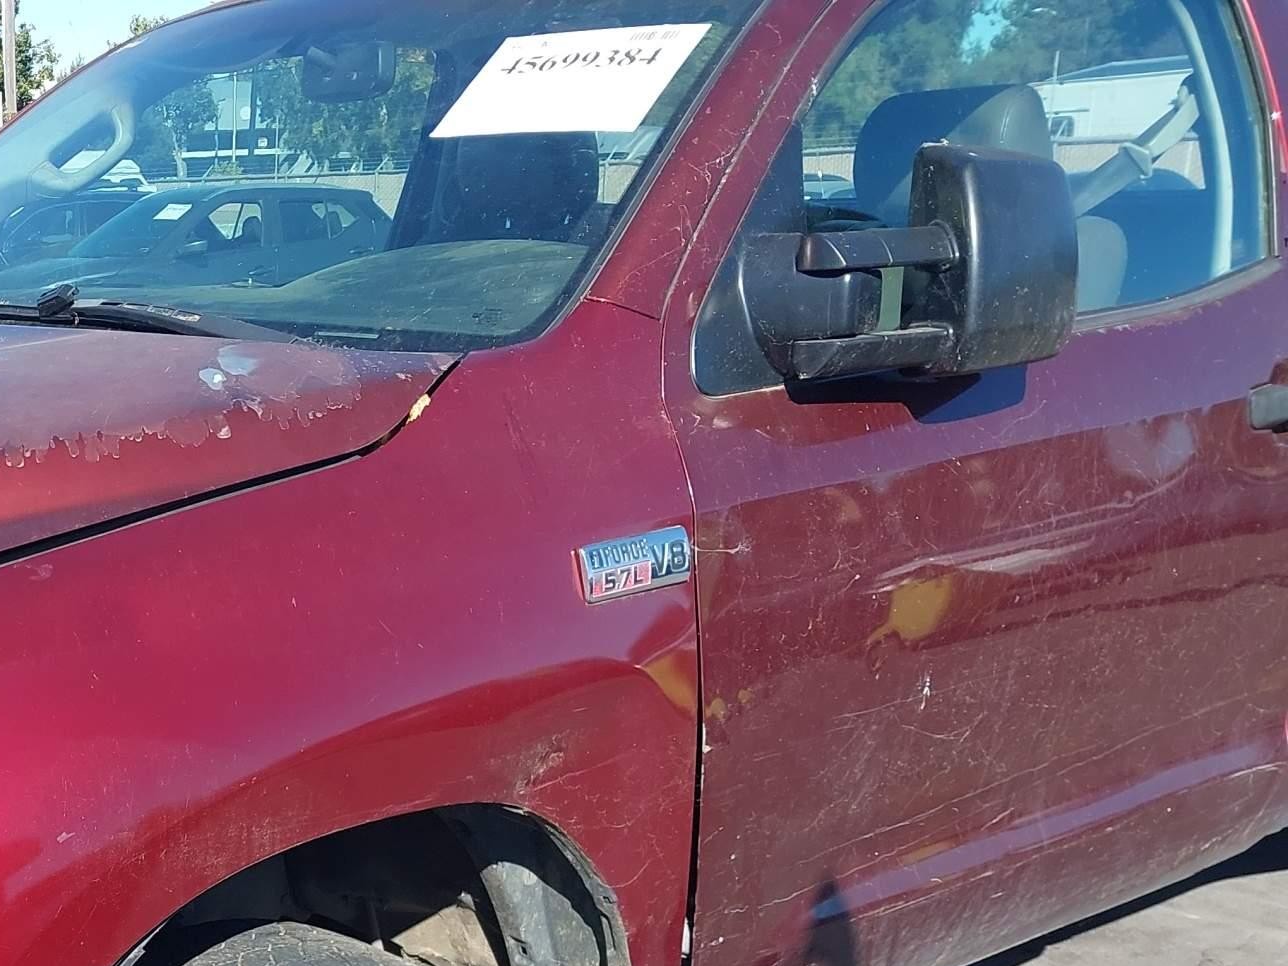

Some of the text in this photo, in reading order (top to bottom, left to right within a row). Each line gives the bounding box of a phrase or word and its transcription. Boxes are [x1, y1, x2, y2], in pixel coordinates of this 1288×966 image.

[500, 47, 663, 75] 45699384
[650, 540, 689, 577] V8
[601, 564, 645, 593] 5.7L
